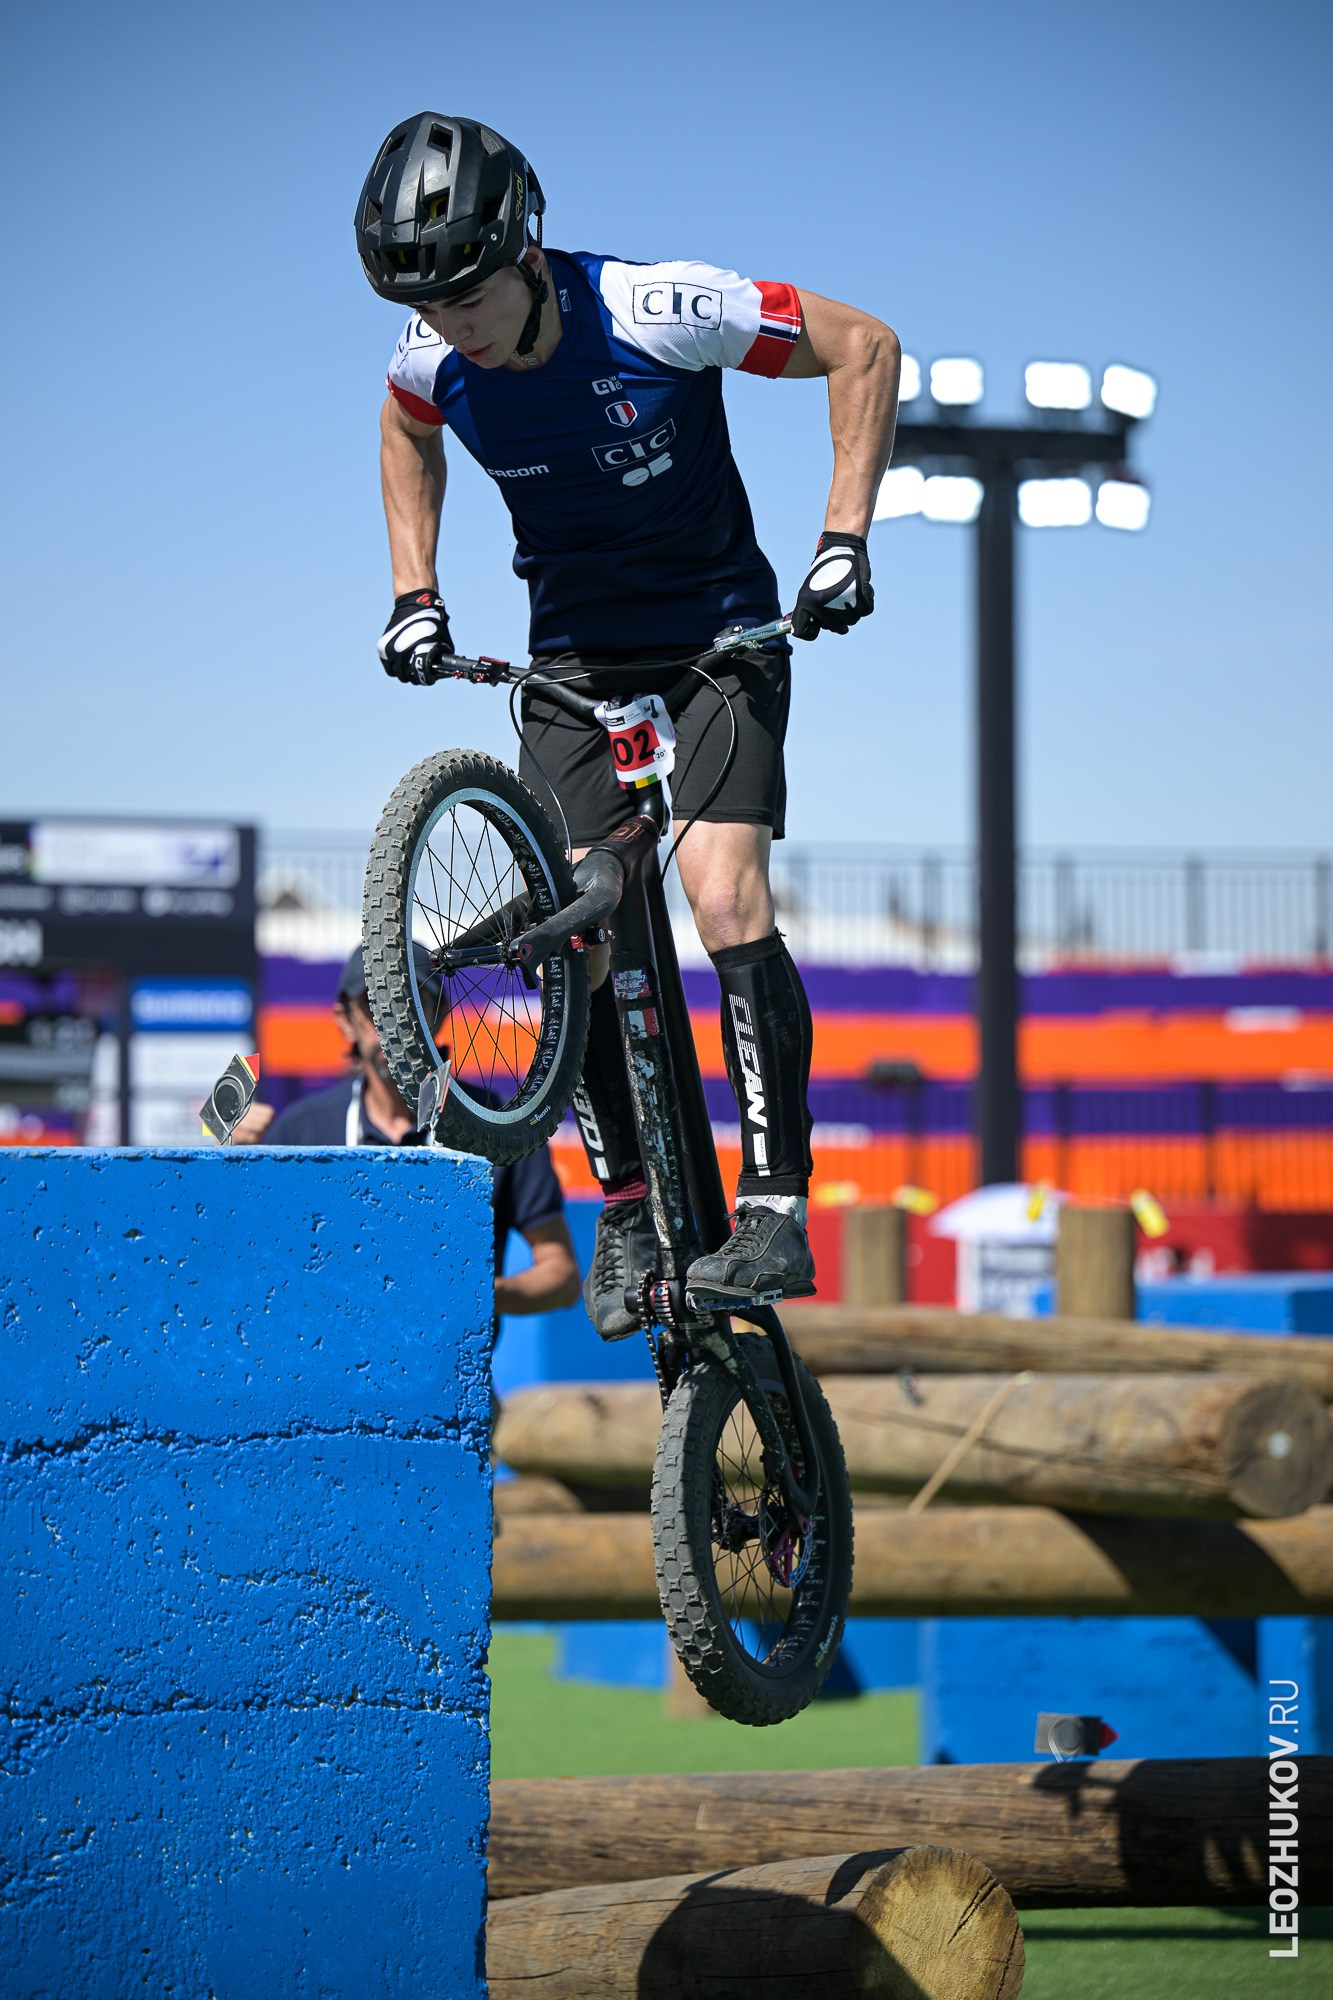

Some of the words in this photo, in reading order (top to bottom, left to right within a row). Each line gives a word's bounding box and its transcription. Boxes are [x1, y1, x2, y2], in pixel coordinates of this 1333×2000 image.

[642, 289, 713, 320] CIC
[604, 429, 670, 465] CIC
[729, 994, 768, 1128] CLEAN
[573, 1080, 604, 1152] CLE
